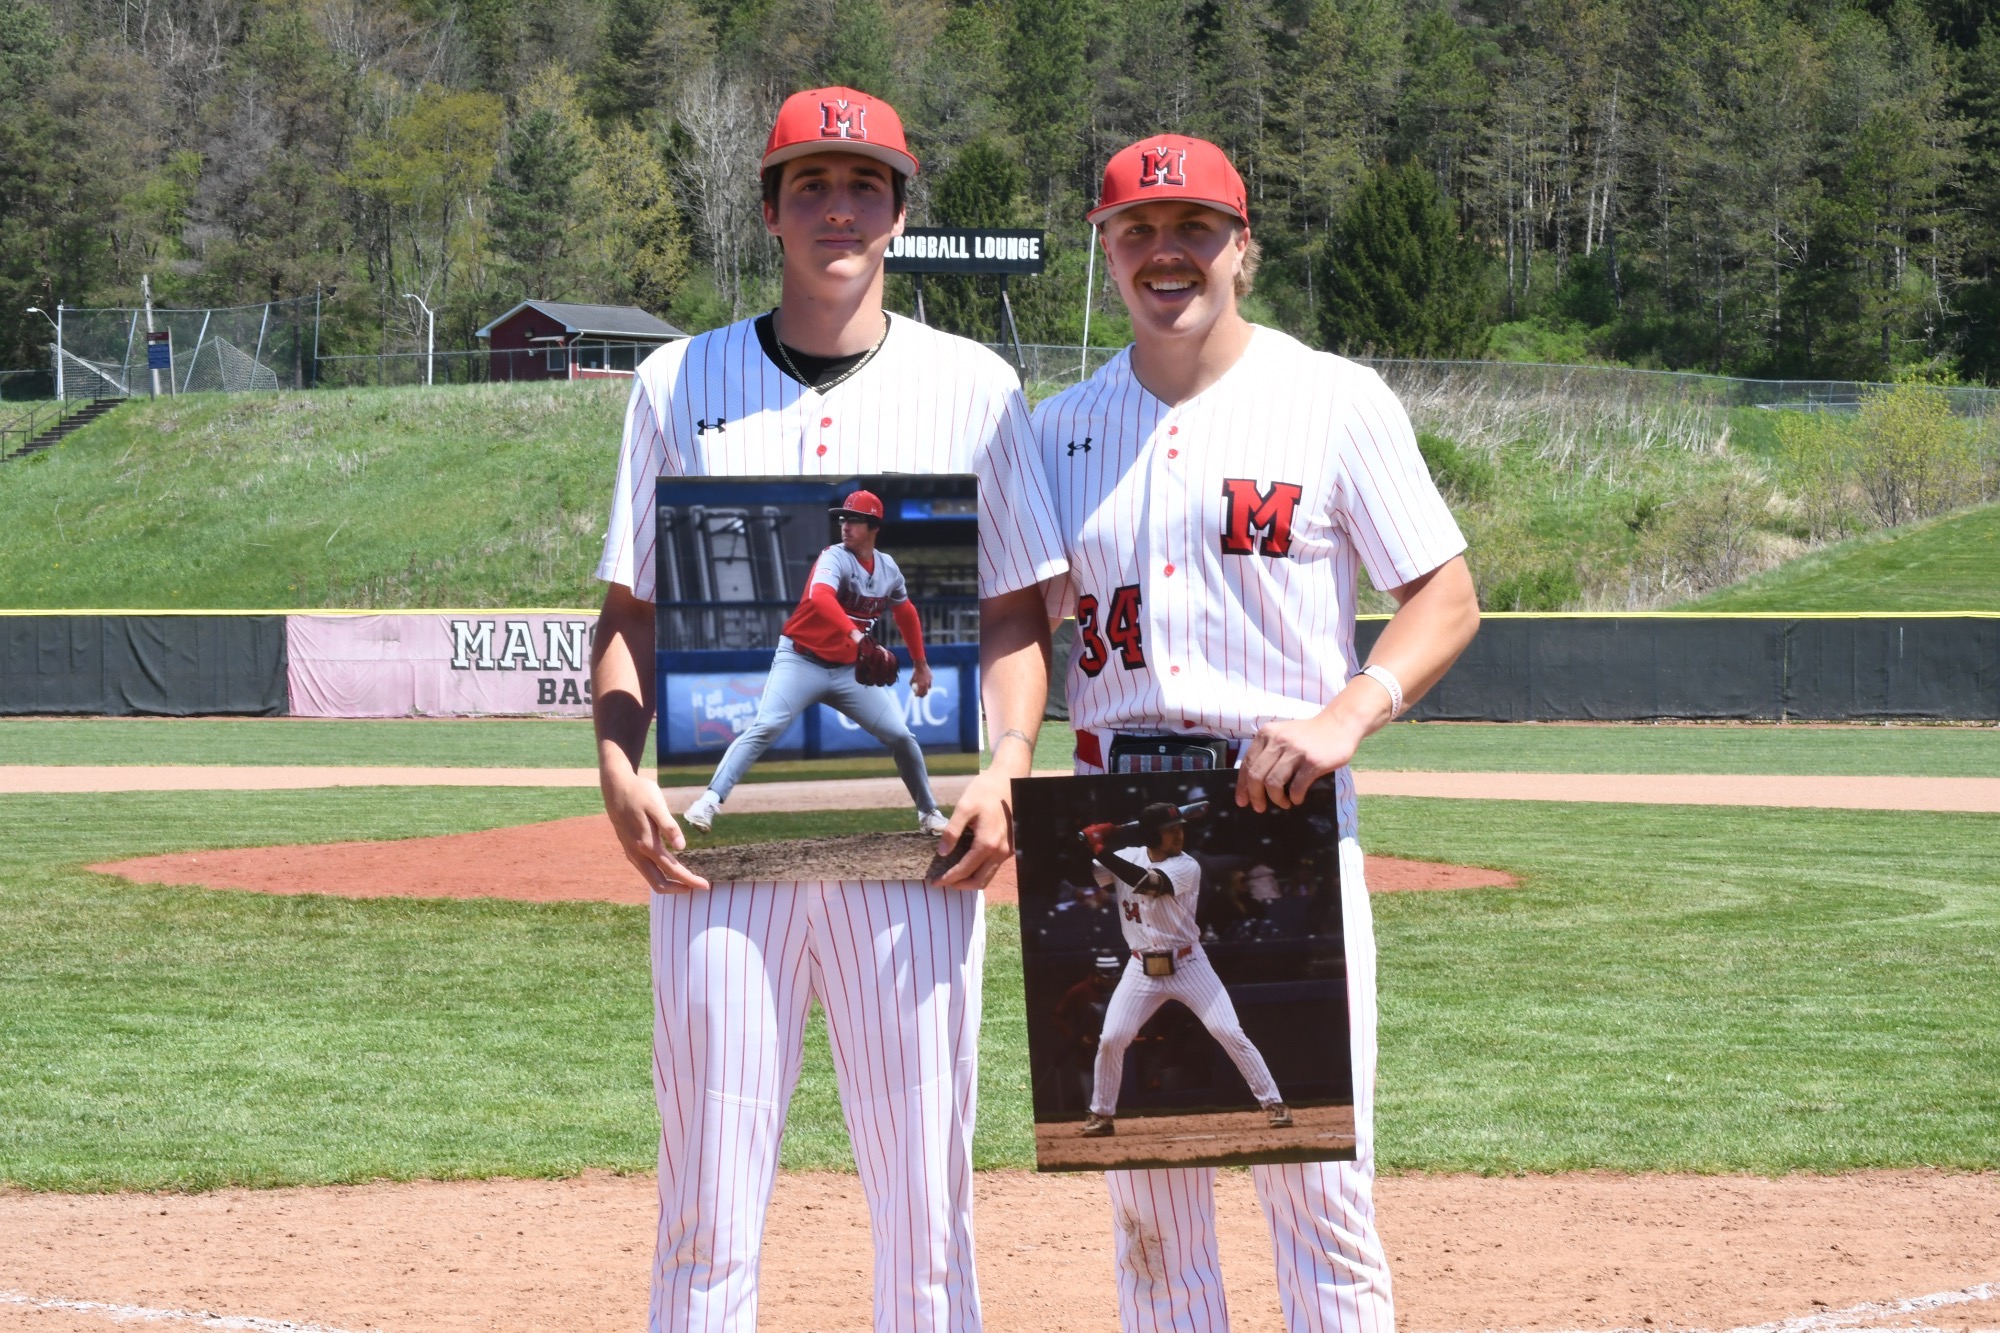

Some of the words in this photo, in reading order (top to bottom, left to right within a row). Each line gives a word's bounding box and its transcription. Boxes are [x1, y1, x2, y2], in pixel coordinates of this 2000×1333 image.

[821, 99, 866, 140] M
[1140, 146, 1187, 188] M
[975, 237, 1039, 260] LOUNGE
[1221, 478, 1303, 558] M
[451, 620, 597, 671] MAN
[1078, 584, 1147, 678] 34
